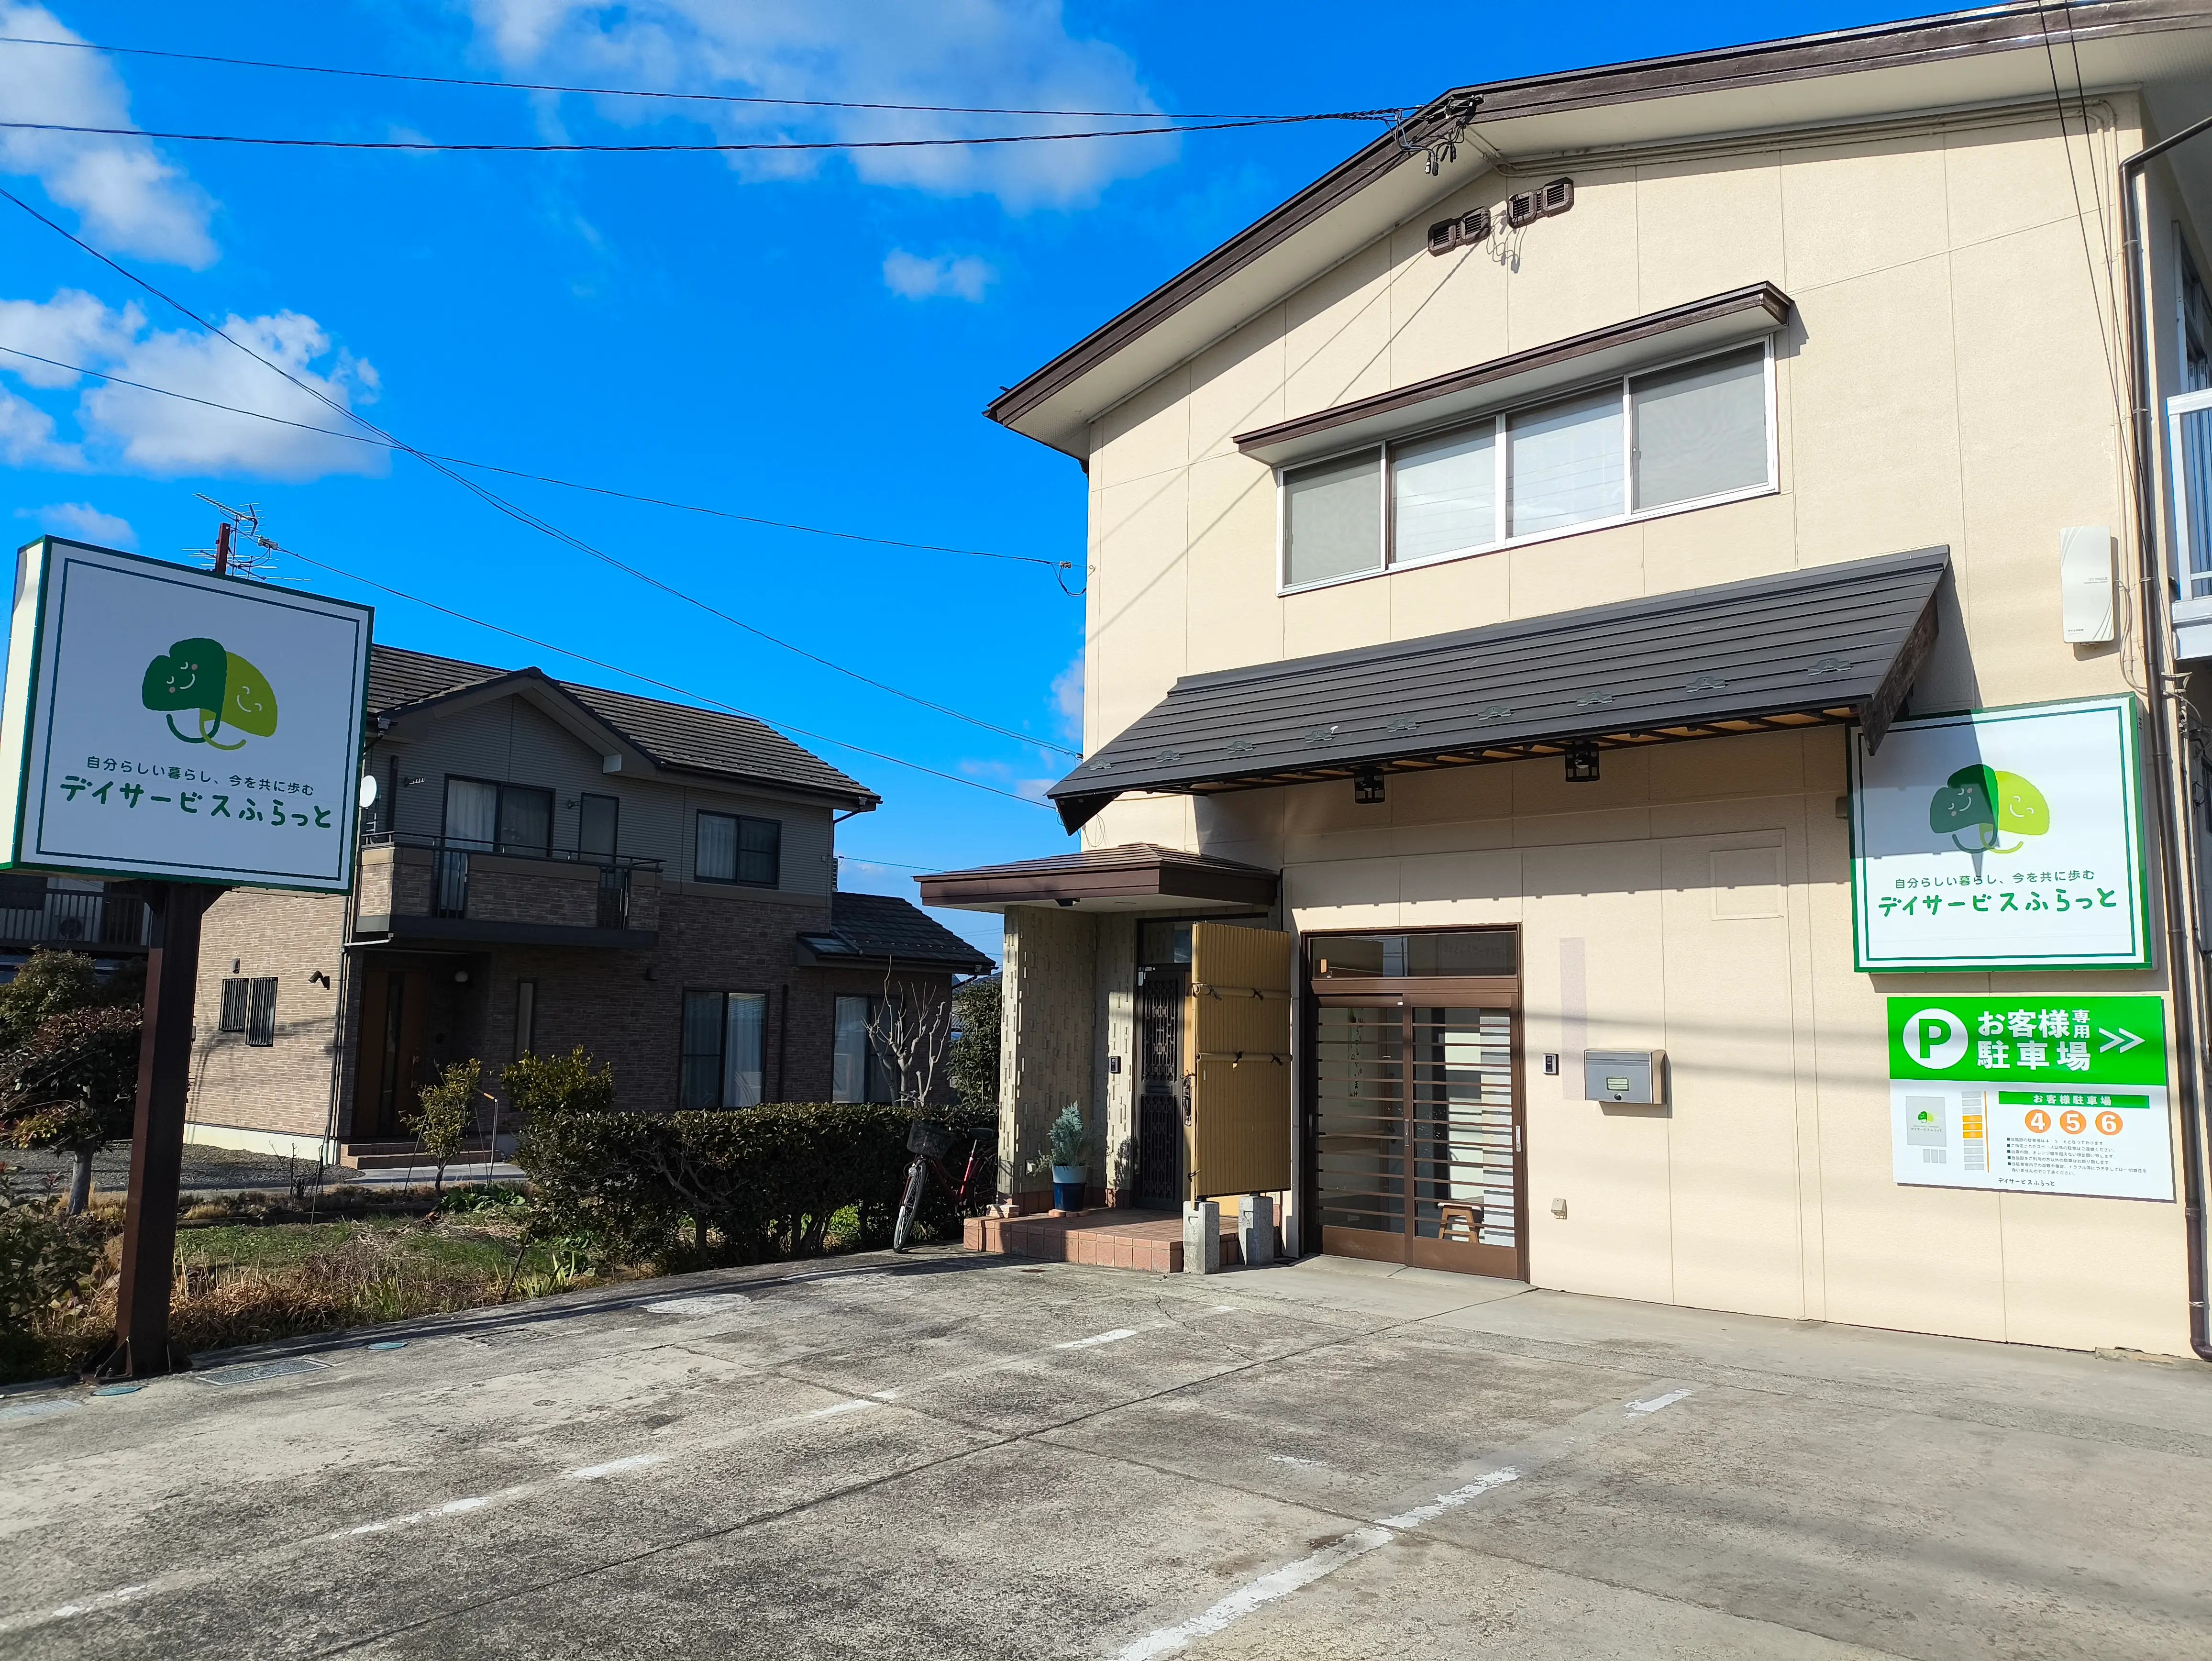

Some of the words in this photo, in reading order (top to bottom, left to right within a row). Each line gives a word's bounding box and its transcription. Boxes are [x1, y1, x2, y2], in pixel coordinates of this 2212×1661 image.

[87, 756, 314, 796] 自分らしい暮らし、今を共に歩む
[60, 775, 331, 828] デイサービスふらっと
[1895, 870, 2095, 889] 自分らしい暮らし、今を共に歩む
[1879, 887, 2116, 917] デイサービスふらっと
[1918, 1018, 1951, 1058] P
[1977, 1040, 2091, 1071] 駐車場
[2033, 1094, 2112, 1106] お客様駐車場
[2031, 1112, 2046, 1130] 4
[2066, 1113, 2080, 1131] 5
[2101, 1114, 2117, 1132] 6
[1998, 1178, 2055, 1186] デイサービスふらっと
